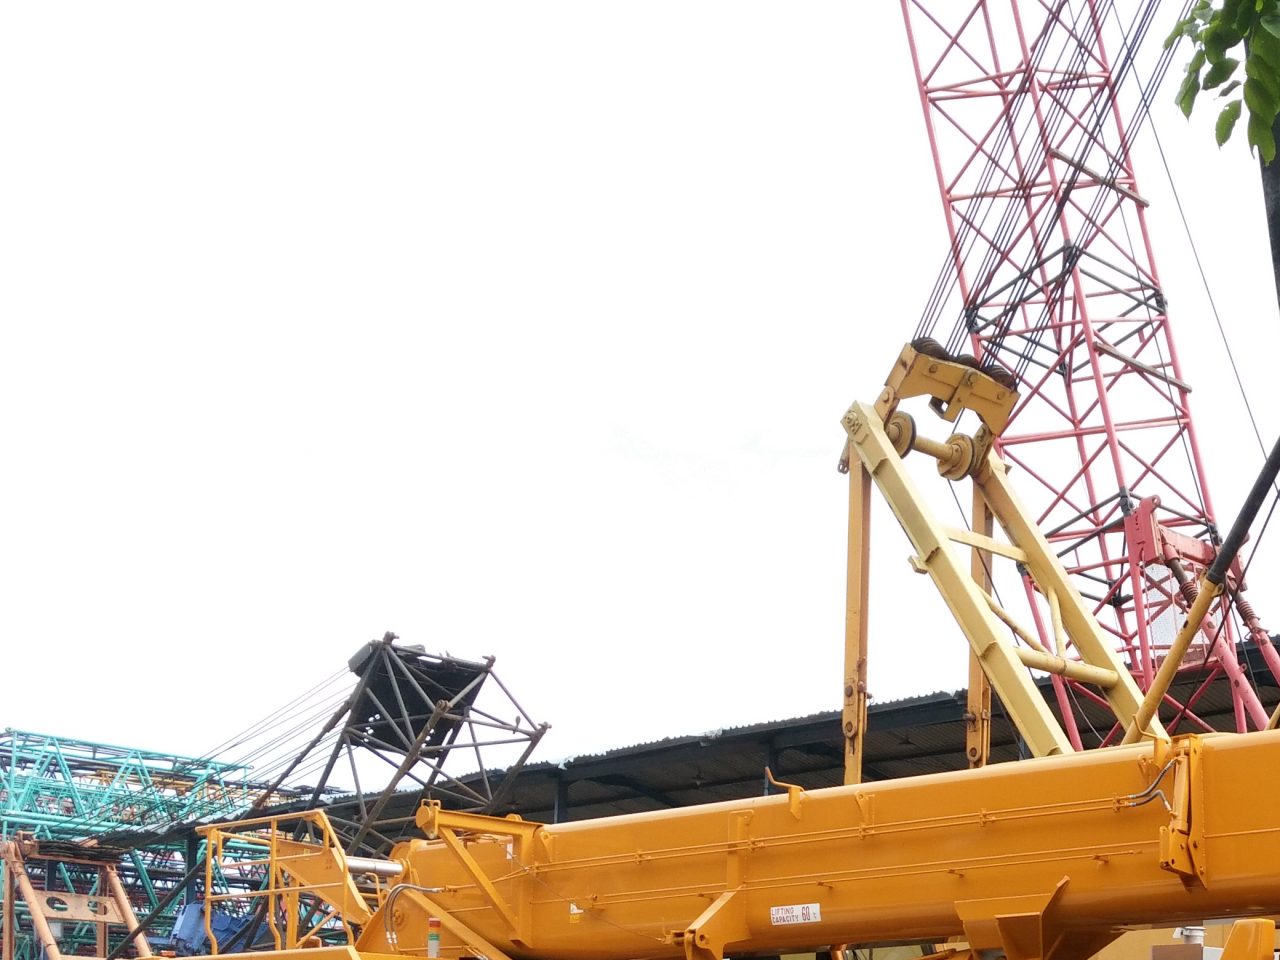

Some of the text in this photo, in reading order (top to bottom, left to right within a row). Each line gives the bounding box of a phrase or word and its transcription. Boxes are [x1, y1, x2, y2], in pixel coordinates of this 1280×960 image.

[771, 906, 795, 916] LIFTING
[801, 906, 811, 921] 60
[772, 914, 799, 924] CAPACITY
